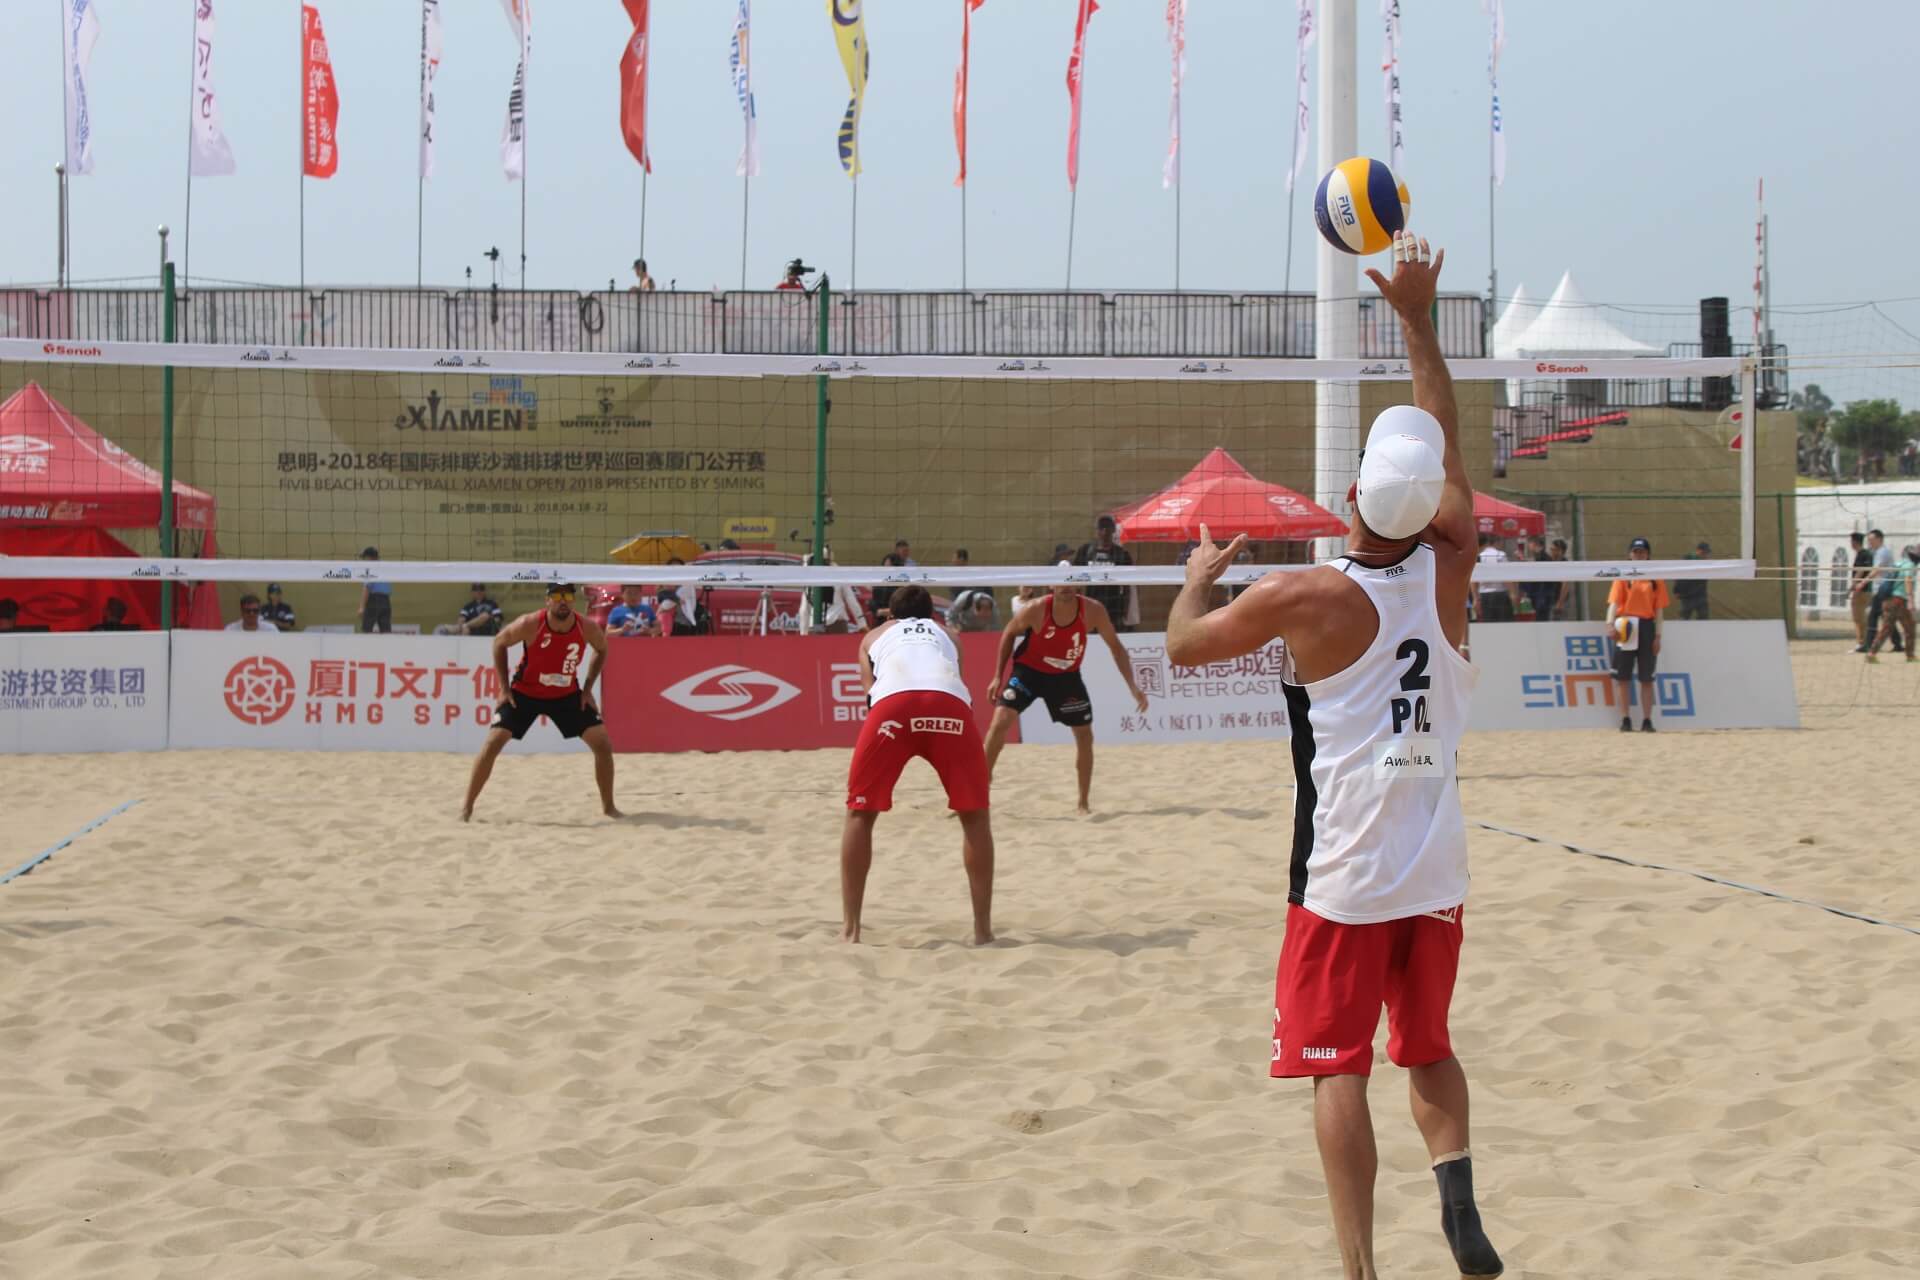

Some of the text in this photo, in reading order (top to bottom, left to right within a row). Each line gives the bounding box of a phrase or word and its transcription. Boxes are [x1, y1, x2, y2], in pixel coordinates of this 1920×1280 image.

[1338, 195, 1356, 226] FIVB
[56, 345, 102, 357] Senoh
[1547, 364, 1588, 374] Senoh
[279, 476, 765, 492] FIVB BEACH VOLLEYBALL XIAMEN OPEN 2018 PRESENTED BY SIMING
[1071, 631, 1080, 650] 1
[566, 642, 580, 661] 2
[562, 660, 577, 674] ES
[1395, 638, 1430, 692] 2
[1, 668, 145, 697] 游投资集团
[307, 660, 500, 700] 厦门文广体
[1170, 680, 1284, 698] PETER CAST
[49, 696, 87, 709] GROUP
[126, 695, 146, 708] LTD
[914, 719, 961, 732] ORLEN
